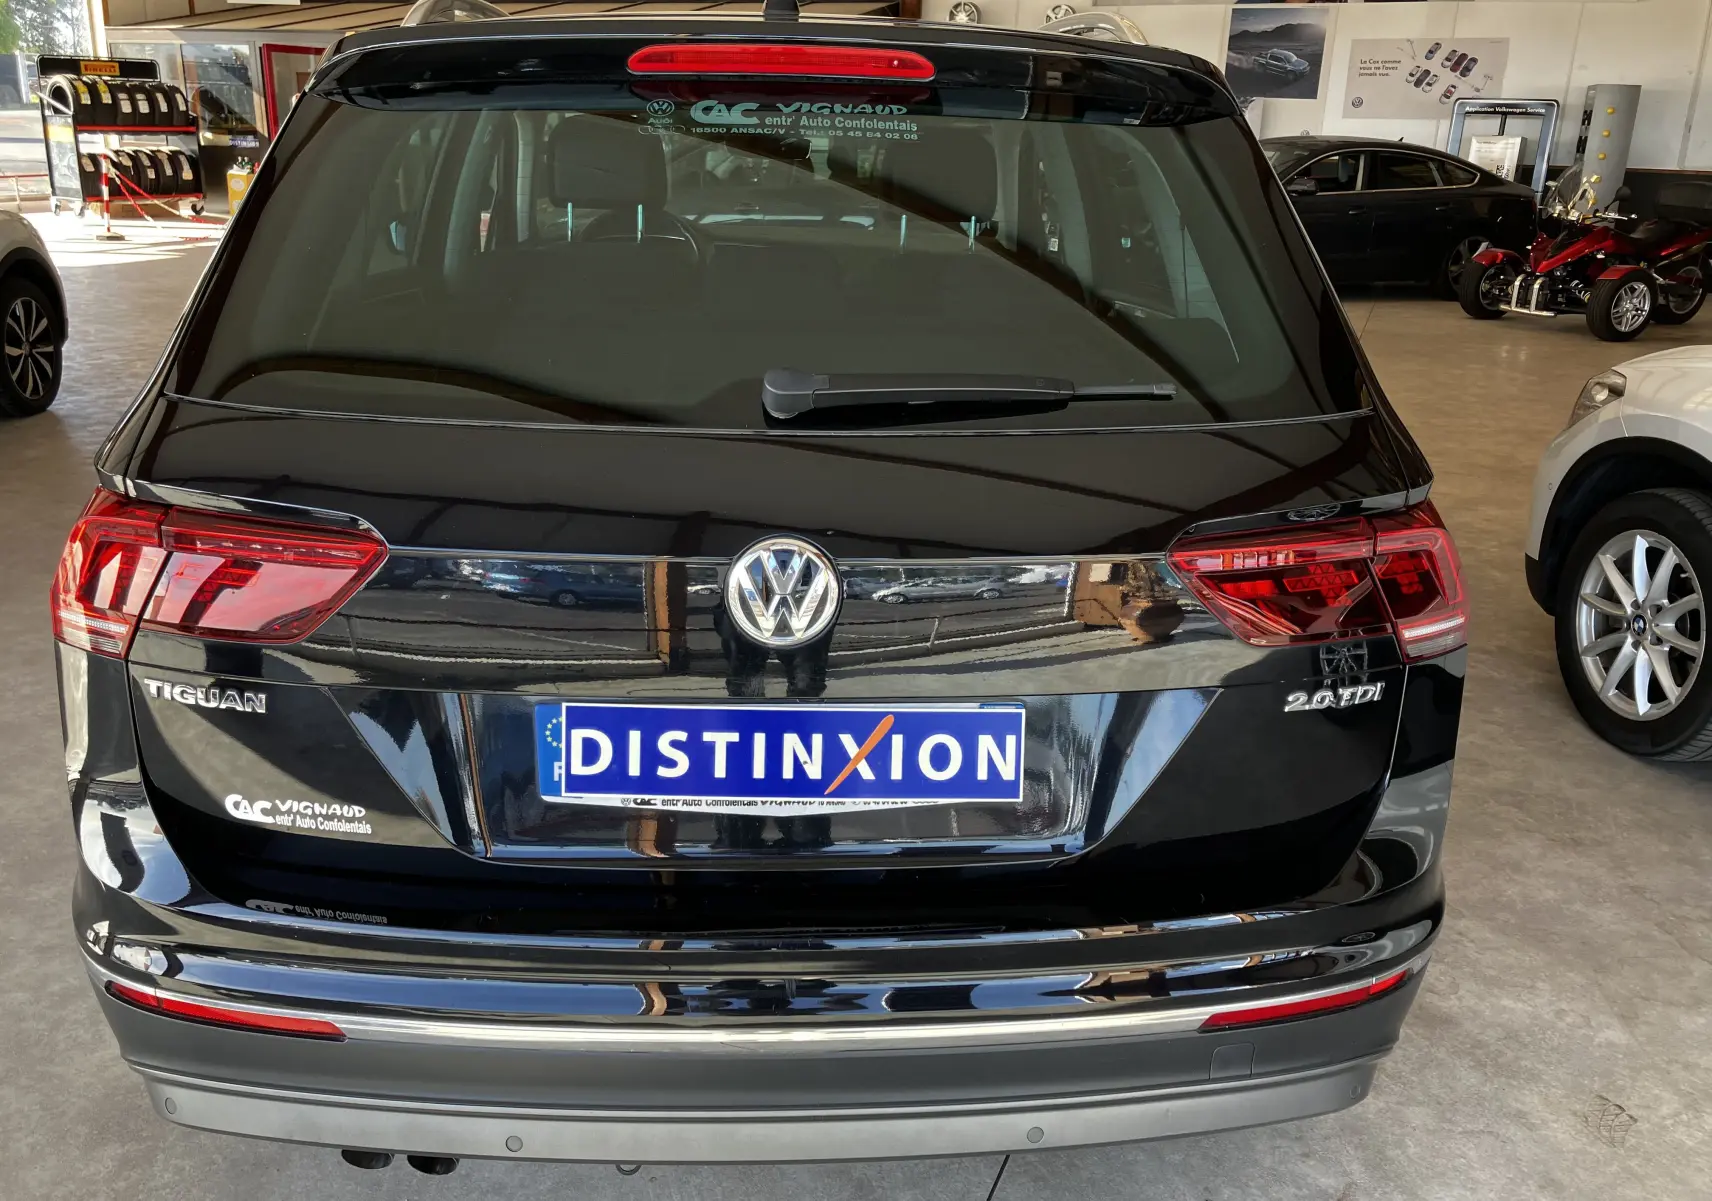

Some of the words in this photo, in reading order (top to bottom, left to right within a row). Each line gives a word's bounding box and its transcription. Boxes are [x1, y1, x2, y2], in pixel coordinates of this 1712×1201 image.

[84, 64, 116, 73] PIRELLI
[690, 99, 760, 124] CAC
[776, 102, 907, 115] VIGNAUD
[765, 116, 796, 126] entr'
[799, 115, 831, 127] Auto
[834, 117, 918, 131] Confolentais
[730, 127, 786, 135] ANSAC/V
[144, 677, 268, 714] TIGUAN
[1284, 690, 1335, 713] 2.0
[1336, 682, 1386, 707] TDI
[570, 714, 1017, 795] DISTINXION
[224, 793, 276, 824] CAC
[275, 799, 366, 818] VIGNAUD
[276, 815, 294, 827] entr'
[295, 816, 316, 830] Auto
[317, 816, 372, 835] Confolentais
